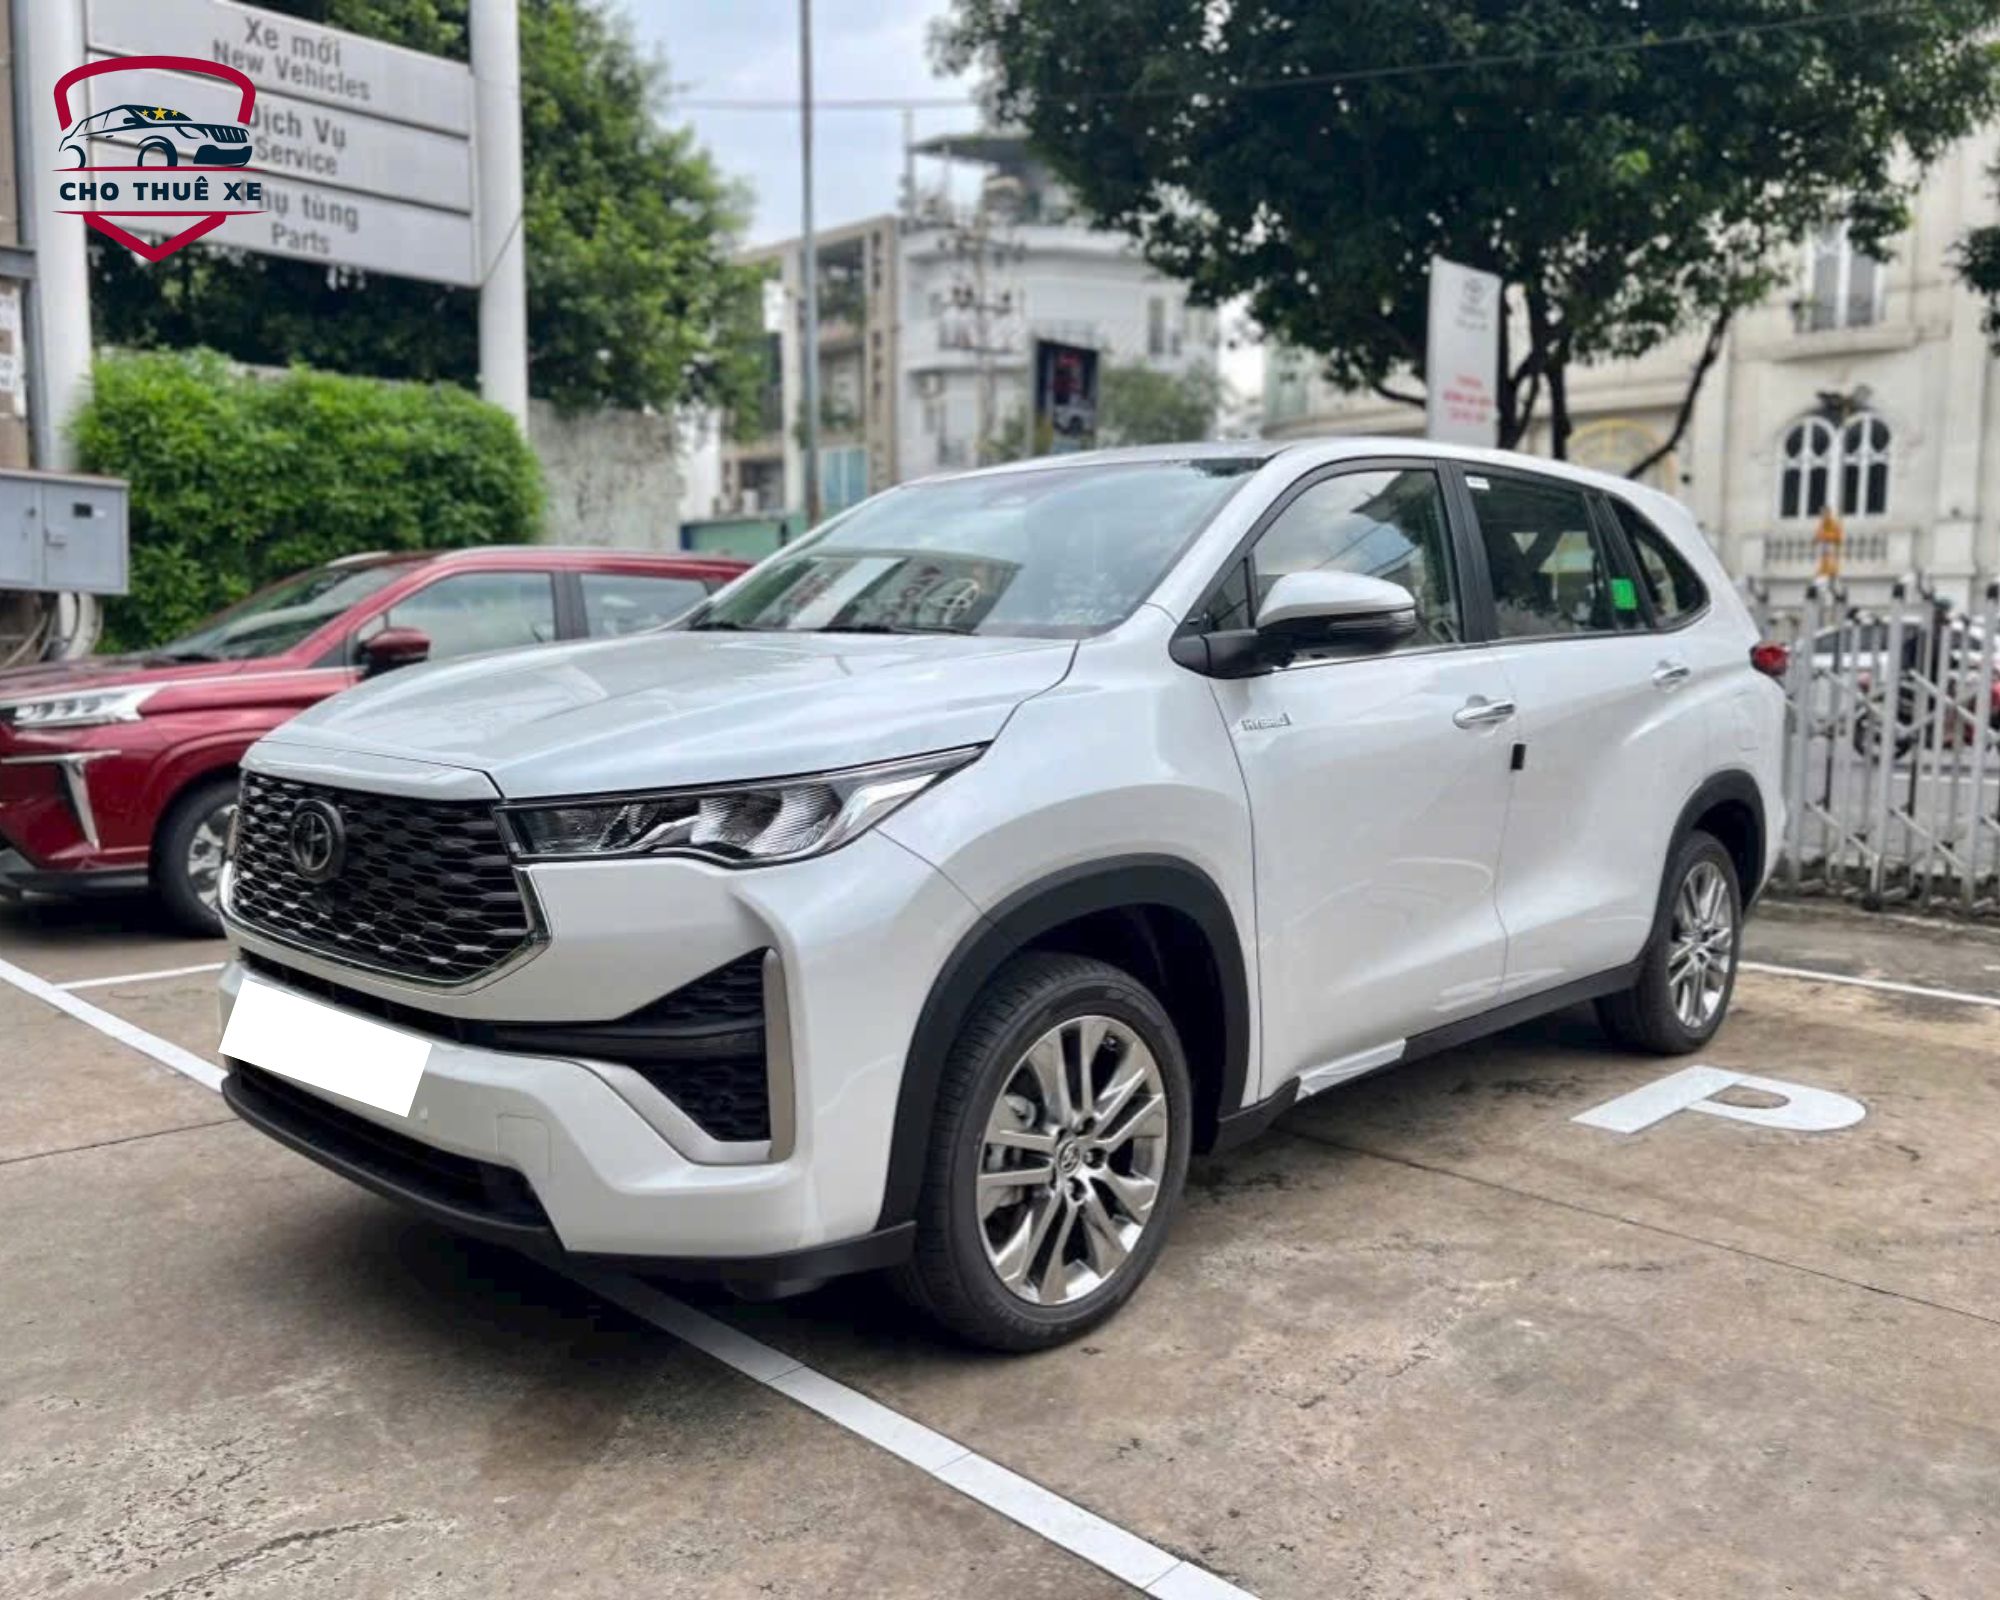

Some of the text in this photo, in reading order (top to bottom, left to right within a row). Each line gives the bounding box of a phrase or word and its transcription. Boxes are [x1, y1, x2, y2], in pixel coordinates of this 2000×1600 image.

[245, 16, 279, 50] Xe
[213, 38, 370, 101] New Vehicles
[314, 116, 346, 152] Vụ
[255, 136, 337, 176] Service
[271, 221, 329, 255] Parts
[1570, 1064, 1867, 1134] P
